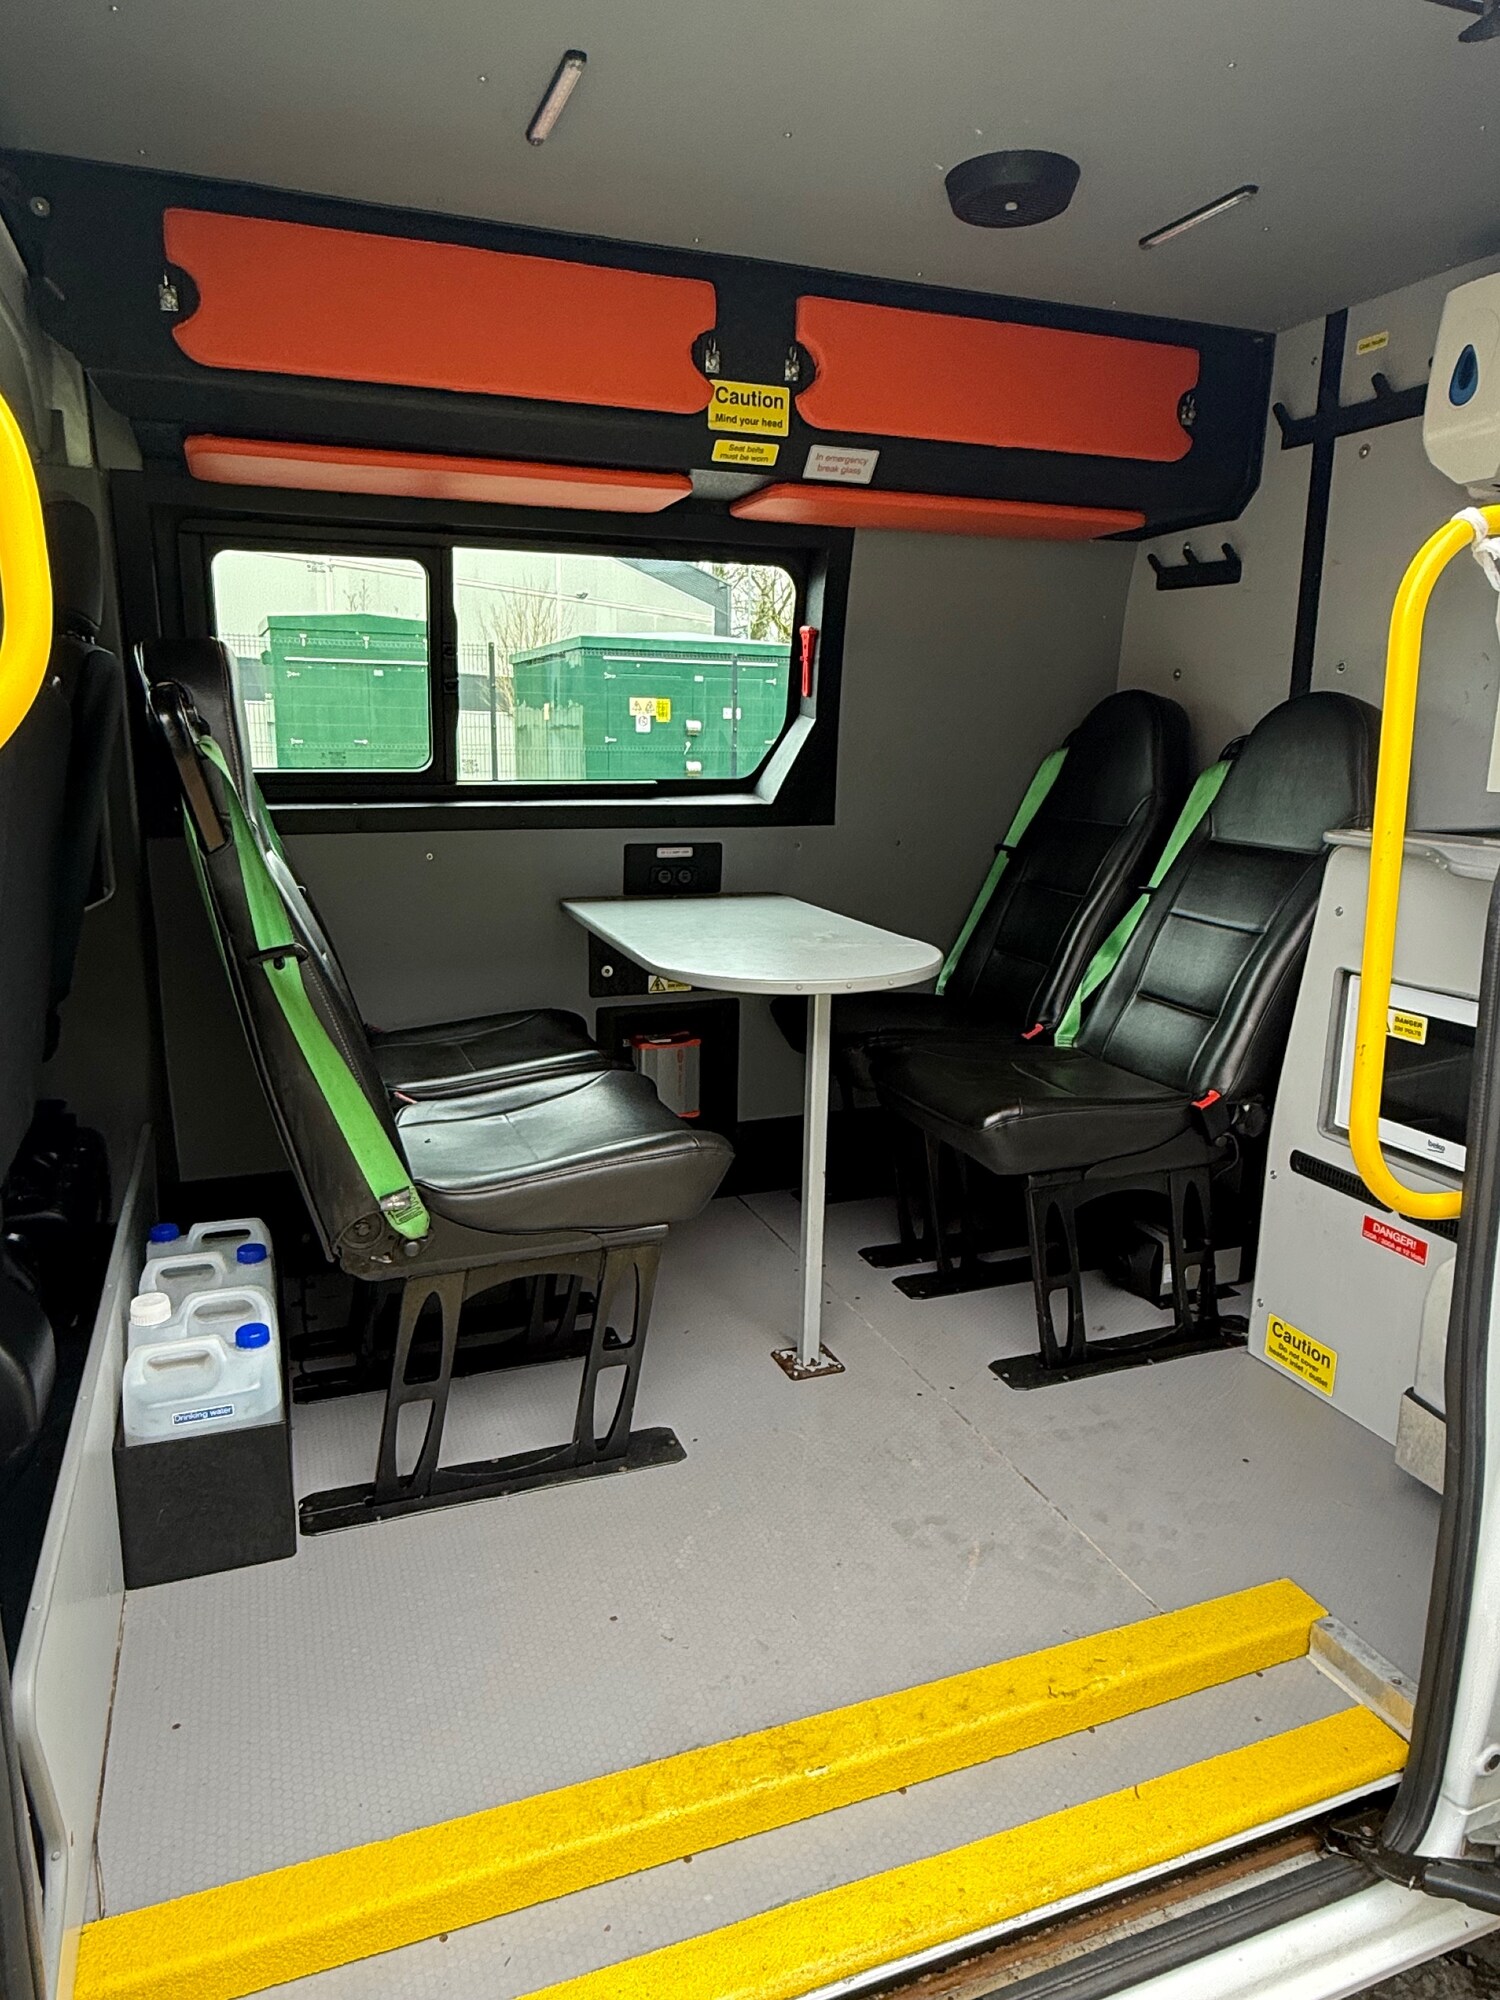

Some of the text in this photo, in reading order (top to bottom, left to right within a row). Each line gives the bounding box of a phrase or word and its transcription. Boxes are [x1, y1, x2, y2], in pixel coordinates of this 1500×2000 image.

[715, 386, 784, 409] Caution
[715, 413, 783, 428] Mind your head
[729, 443, 764, 454] Seat belts
[815, 453, 868, 467] In emergency
[817, 463, 861, 475] break glass
[1394, 1016, 1423, 1028] DANGER
[1428, 1139, 1445, 1151] beko
[1372, 1222, 1417, 1250] DANGER!
[1402, 1247, 1410, 1256] 12
[1410, 1252, 1425, 1263] Volts
[1272, 1321, 1331, 1369] Caution
[1278, 1342, 1319, 1372] Do not cover
[1269, 1345, 1288, 1362] heater
[1289, 1358, 1303, 1372] inlet
[1308, 1372, 1328, 1388] outlet
[174, 1407, 231, 1422] Drinking water
